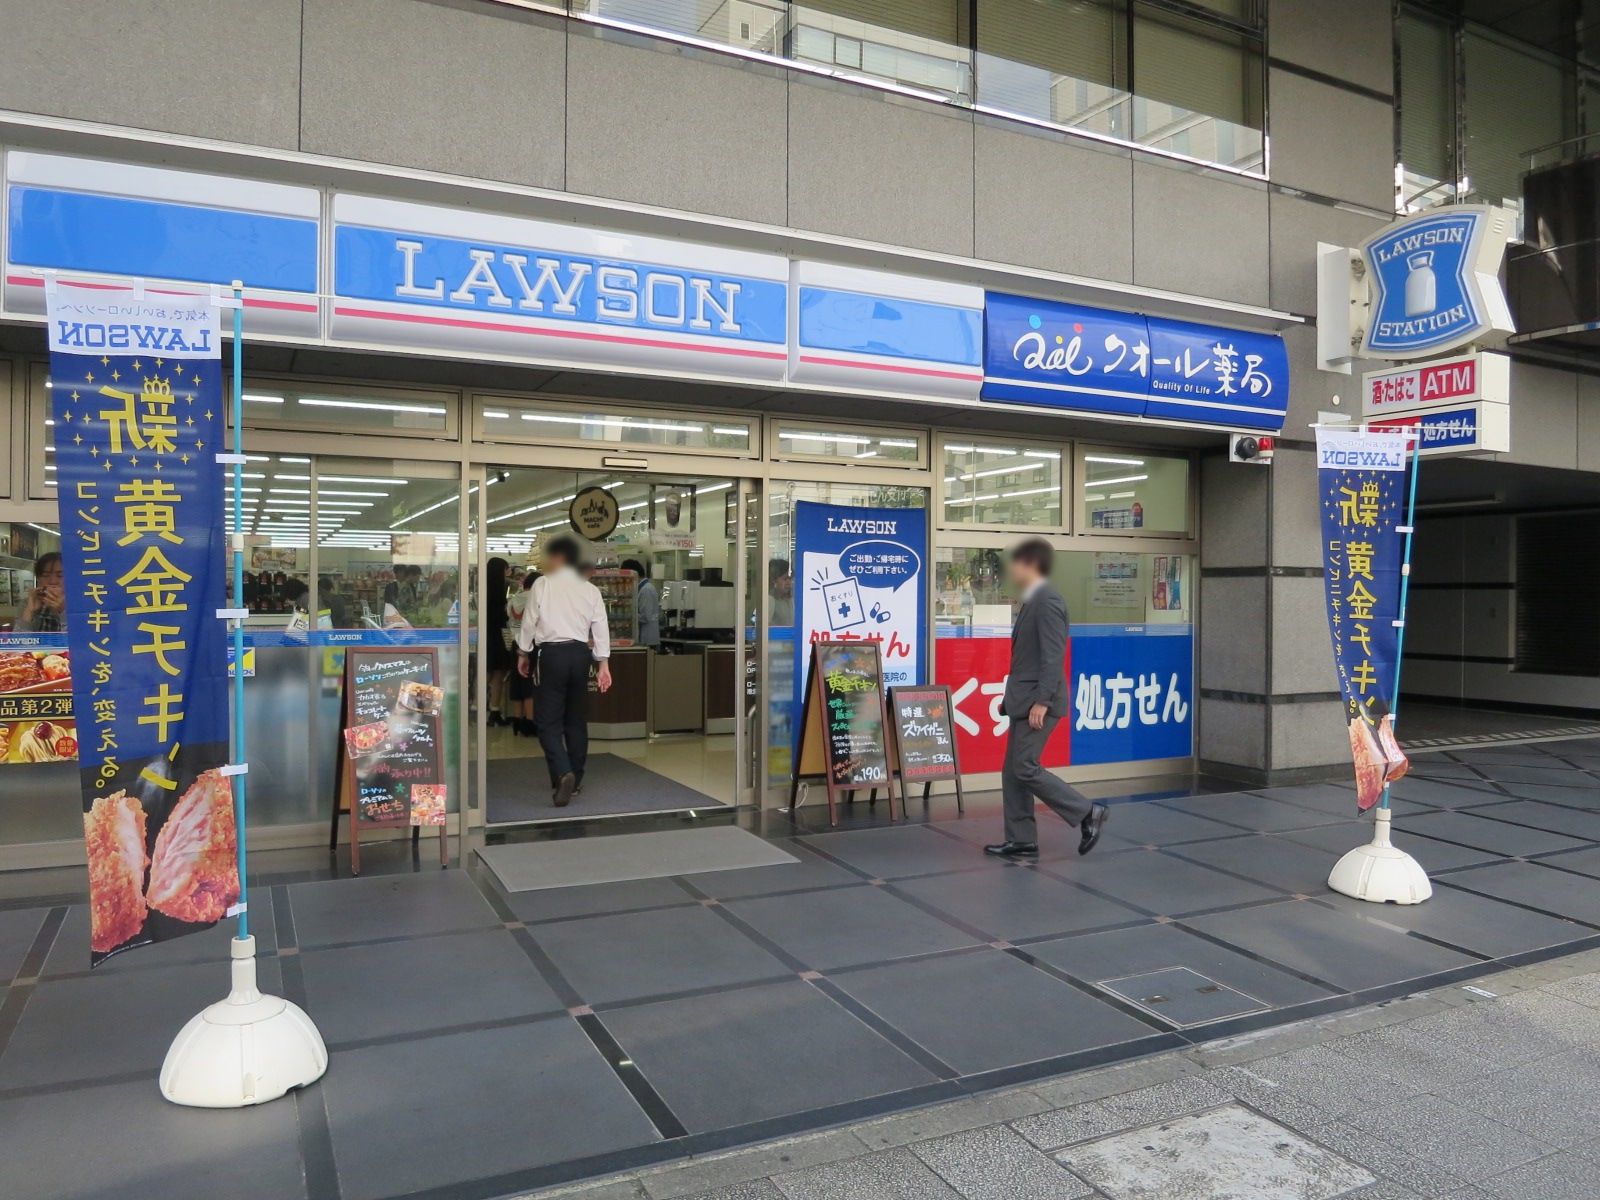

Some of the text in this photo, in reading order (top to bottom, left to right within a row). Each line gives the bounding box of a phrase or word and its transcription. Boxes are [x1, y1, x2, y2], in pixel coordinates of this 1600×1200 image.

[1378, 227, 1465, 264] LAWSON
[395, 239, 742, 336] LAWSON
[1379, 304, 1466, 338] STATION
[1103, 333, 1273, 398] クオール薬局
[1152, 380, 1210, 395] Quality Of Life
[1423, 365, 1472, 398] ATM
[1423, 416, 1475, 442] 処方せん
[827, 517, 897, 535] LAWSON
[0, 637, 40, 645] LAWSON
[826, 669, 877, 694] 黄金チキン
[1075, 671, 1188, 732] 処方せん
[902, 720, 945, 738] ズワイガニ
[366, 800, 405, 815] おせち
